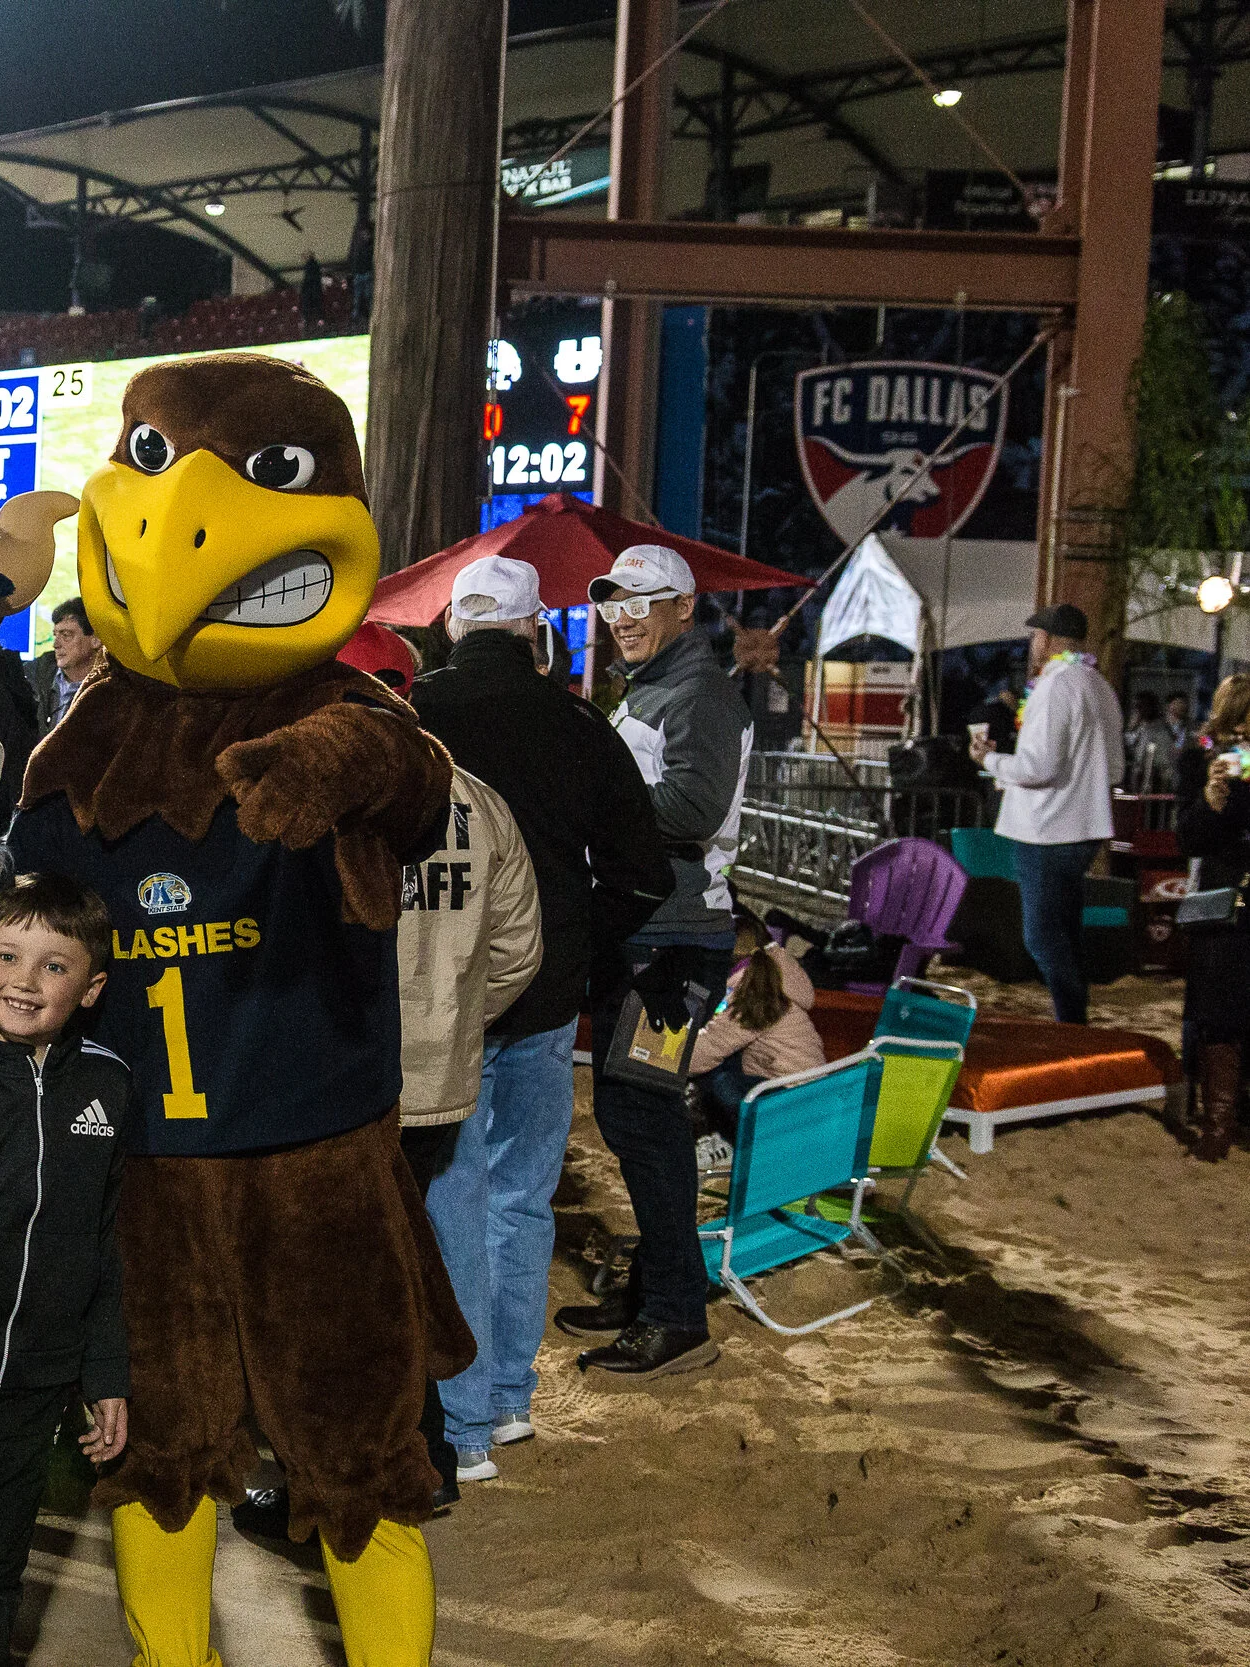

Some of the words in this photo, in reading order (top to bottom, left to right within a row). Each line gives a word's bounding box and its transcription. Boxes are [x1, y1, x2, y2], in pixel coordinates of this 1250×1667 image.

[53, 369, 84, 397] 25
[811, 377, 854, 427] FC
[867, 374, 990, 432] DALLAS
[565, 394, 592, 435] 7
[492, 440, 587, 485] 12:02
[624, 558, 645, 568] CAFE
[401, 861, 472, 911] AFF
[148, 905, 165, 914] KENT
[166, 904, 187, 913] STATE
[111, 917, 261, 960] LASHES
[146, 966, 209, 1120] 1
[69, 1121, 115, 1137] adidas
